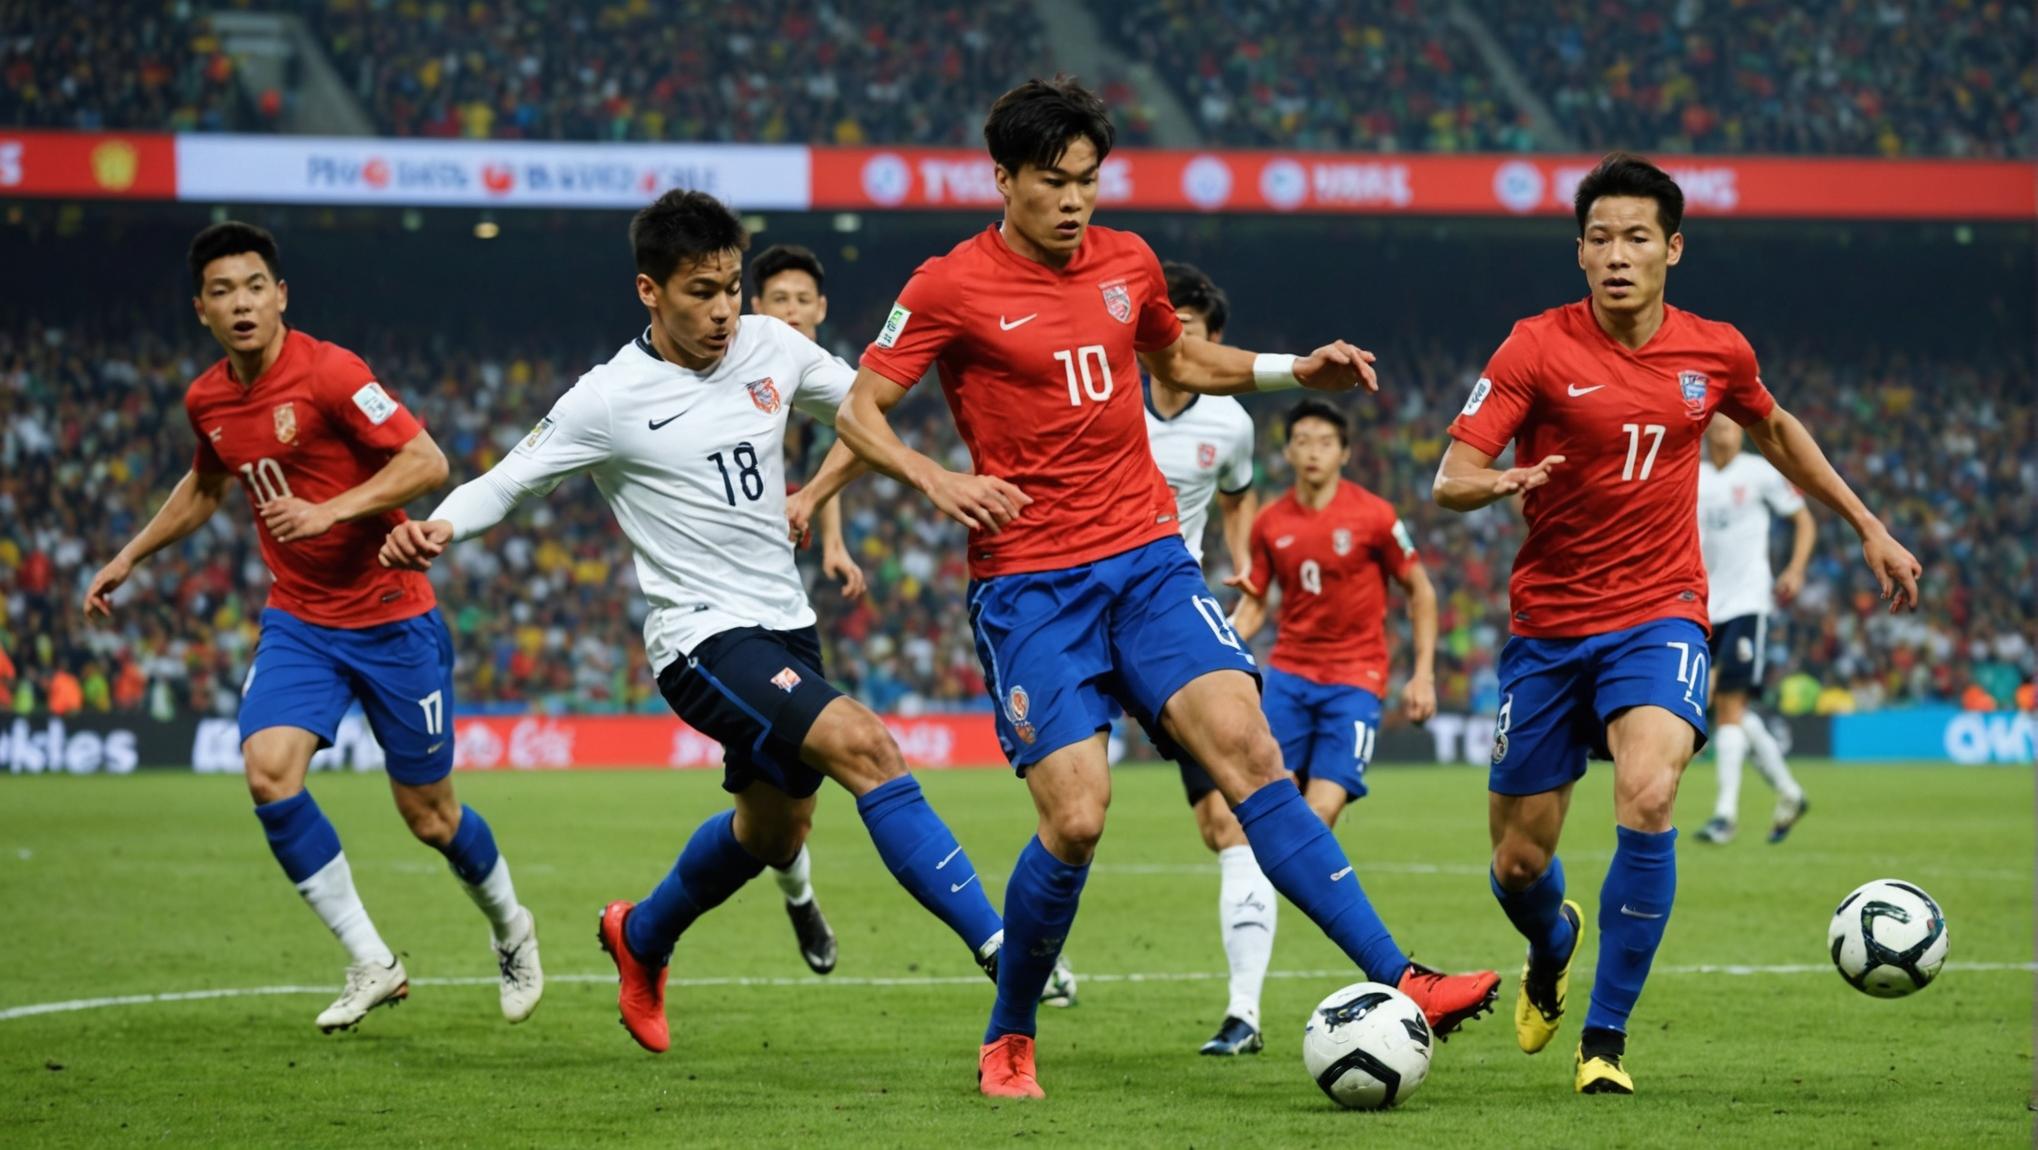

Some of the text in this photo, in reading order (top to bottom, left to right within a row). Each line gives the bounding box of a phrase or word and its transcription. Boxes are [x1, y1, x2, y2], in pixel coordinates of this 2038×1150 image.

[1053, 343, 1114, 406] 10
[706, 440, 765, 507] 18
[1621, 423, 1667, 481] 17
[238, 457, 293, 508] 10
